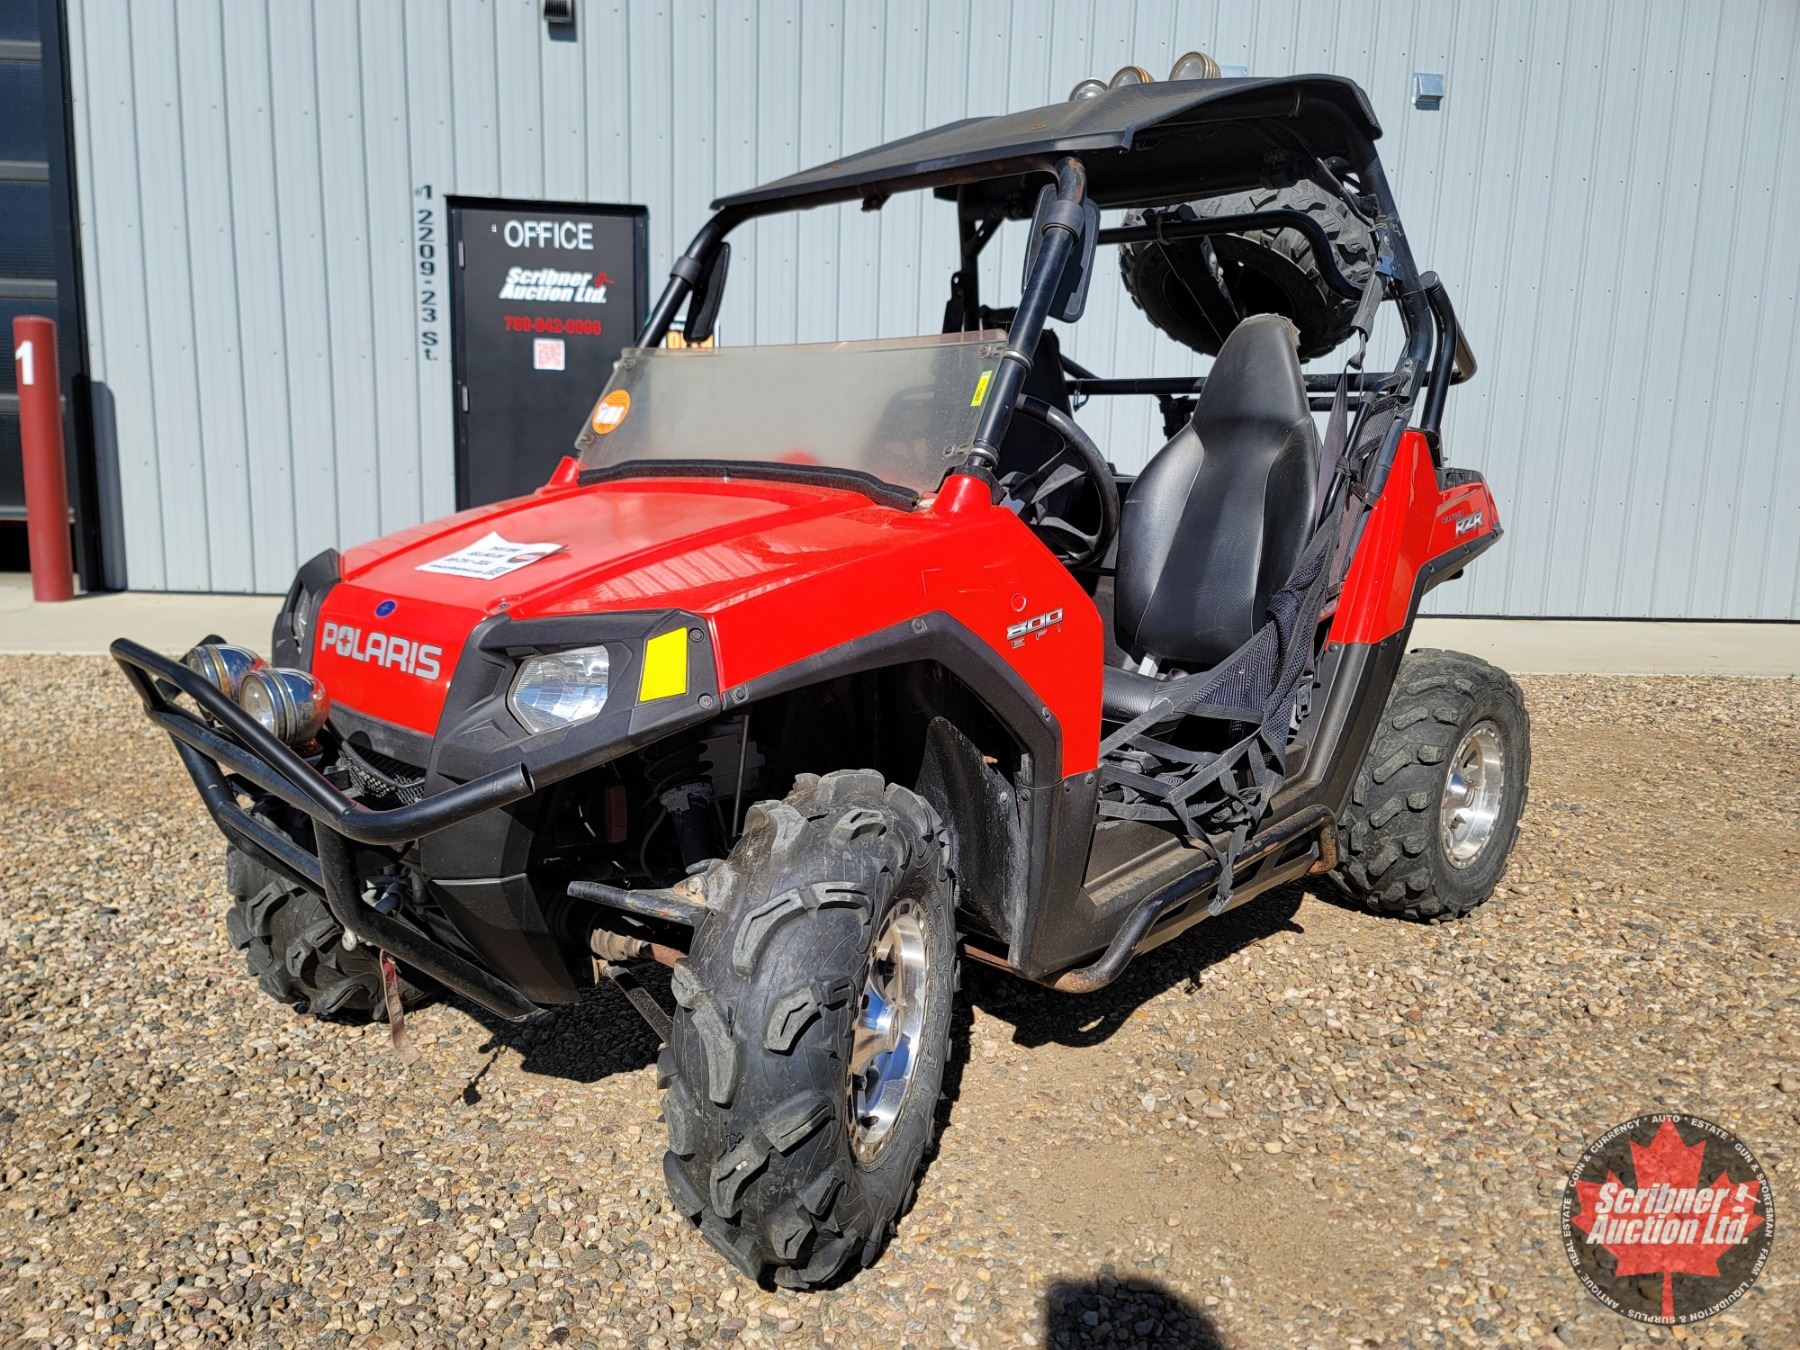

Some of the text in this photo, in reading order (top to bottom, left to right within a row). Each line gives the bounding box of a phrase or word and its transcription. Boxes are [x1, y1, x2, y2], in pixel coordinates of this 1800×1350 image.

[504, 220, 594, 250] OFFICE
[506, 266, 593, 287] Scribner
[499, 283, 607, 303] Auction Ltd.
[15, 340, 34, 385] 1
[1456, 510, 1484, 536] RZR
[1007, 608, 1063, 641] 800
[321, 621, 442, 680] POLARIS
